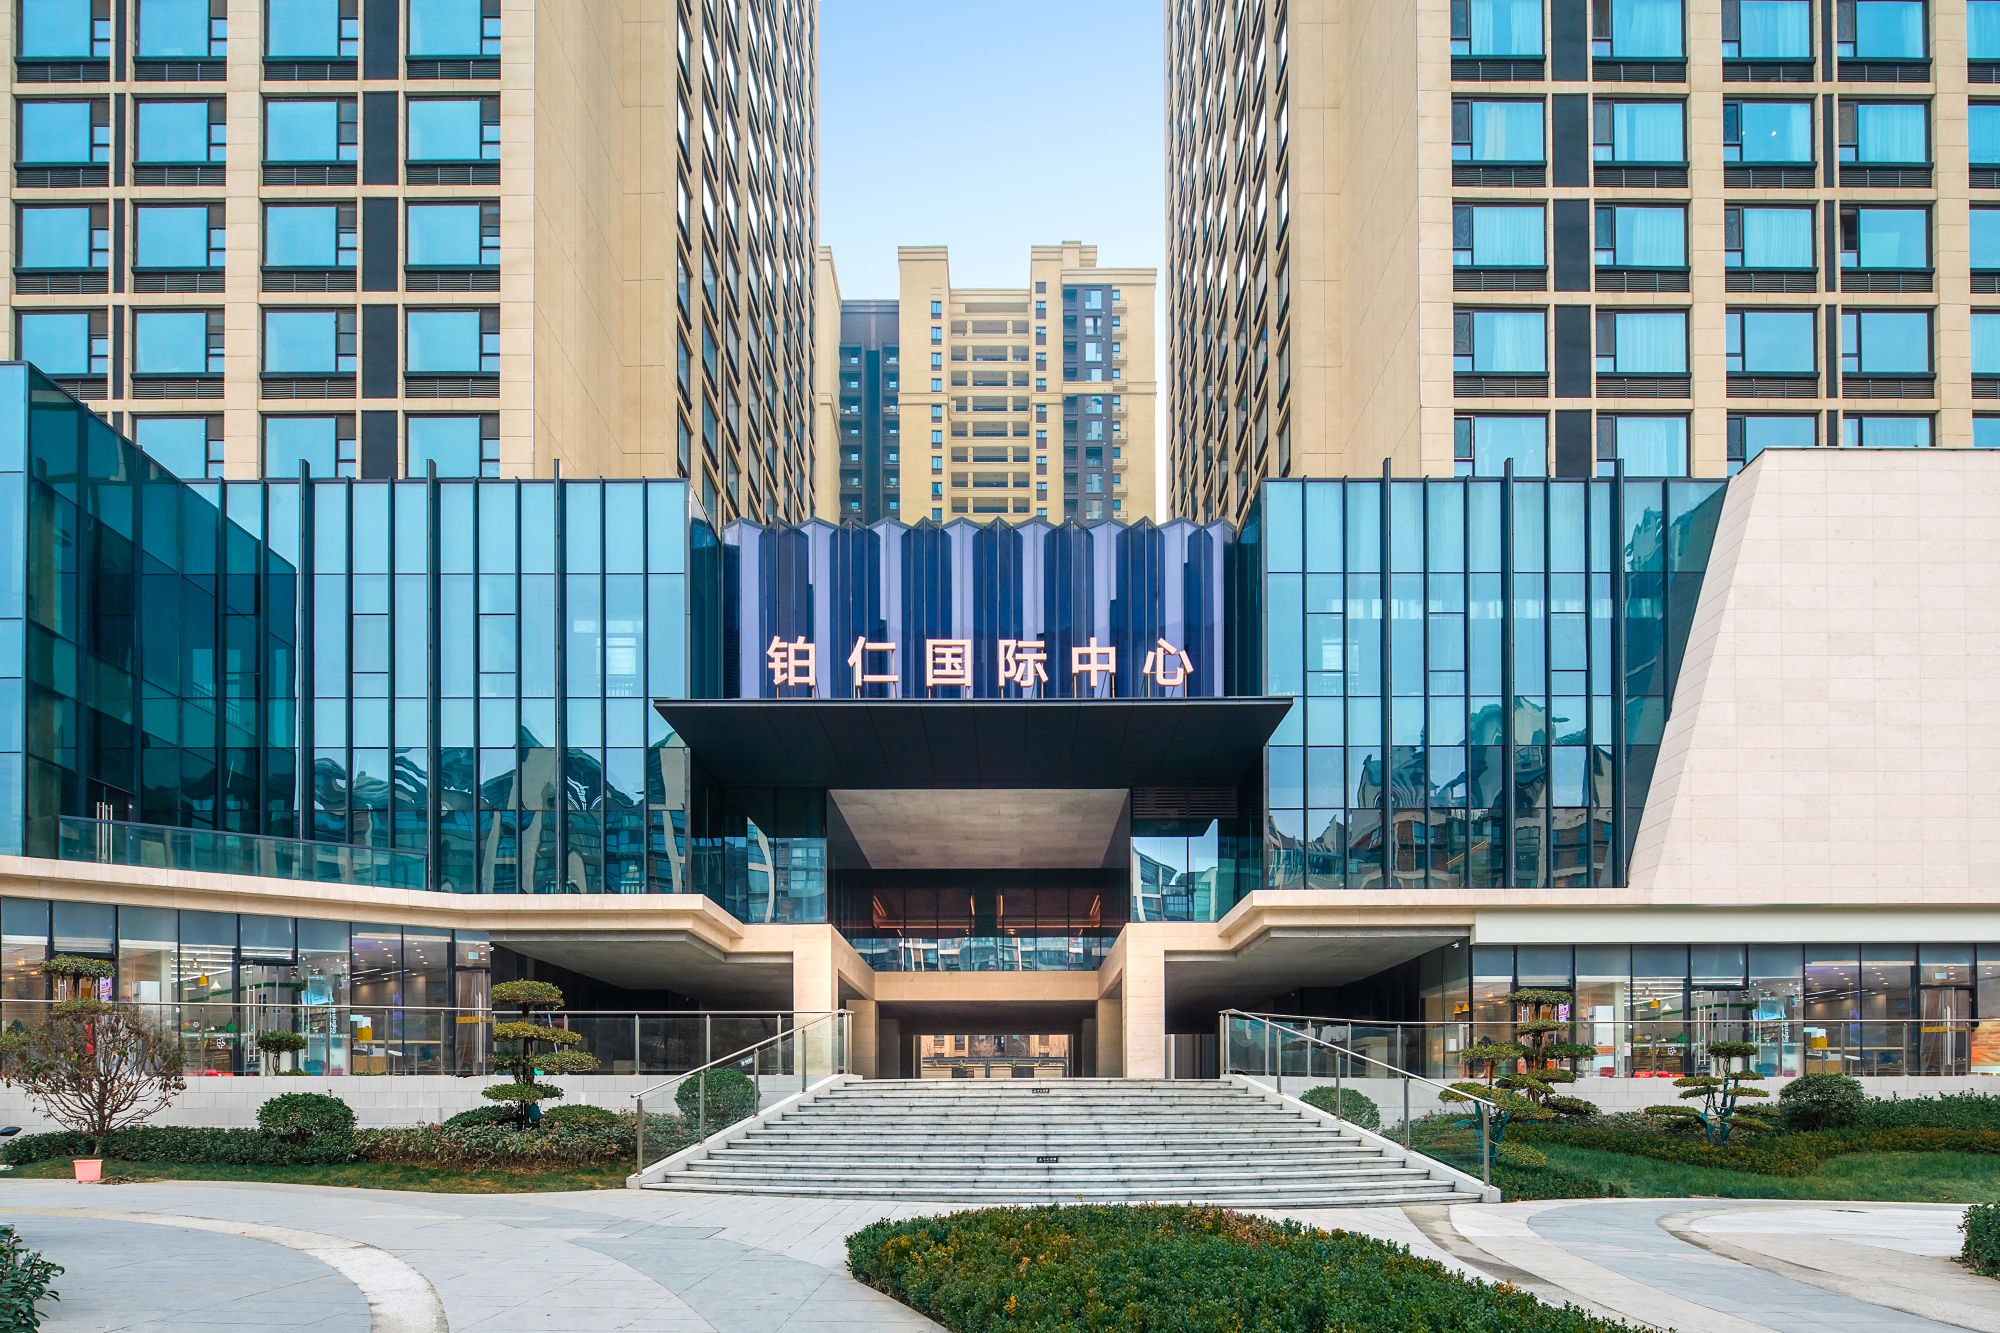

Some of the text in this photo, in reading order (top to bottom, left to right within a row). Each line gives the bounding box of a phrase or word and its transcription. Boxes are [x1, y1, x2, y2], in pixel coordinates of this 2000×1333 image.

[767, 636, 1194, 687] 铂仁国际中心
